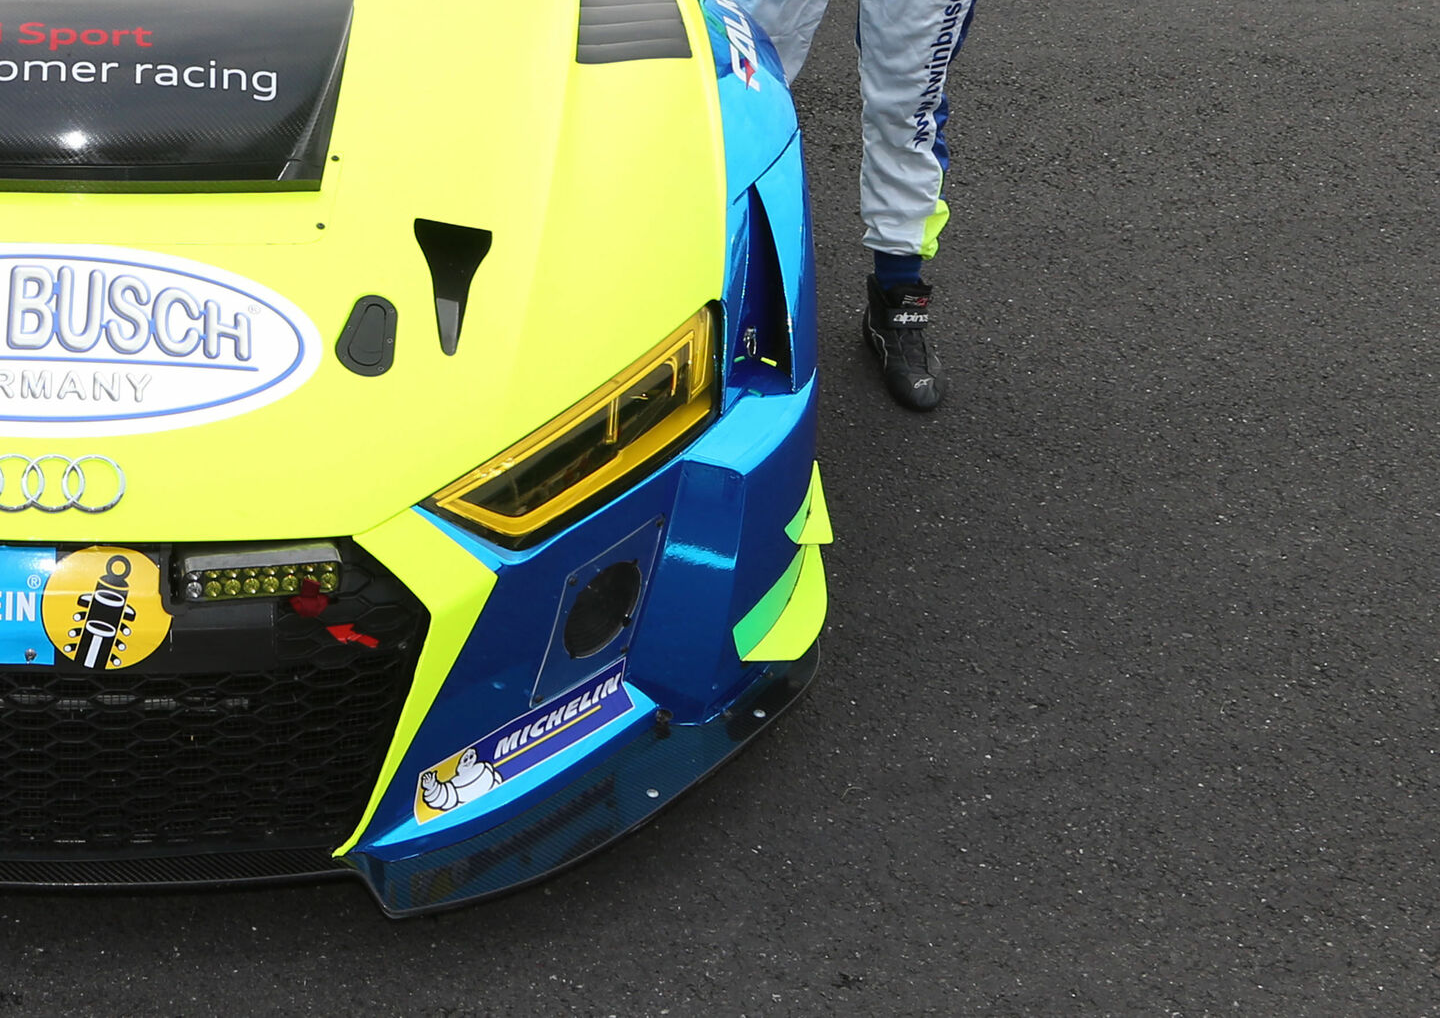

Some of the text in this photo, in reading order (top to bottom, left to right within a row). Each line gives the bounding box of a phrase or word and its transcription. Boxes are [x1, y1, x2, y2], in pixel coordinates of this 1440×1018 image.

[17, 22, 154, 51] Sport
[134, 60, 279, 101] racing
[5, 264, 253, 362] BUSCH
[492, 671, 622, 761] MICHELIN
